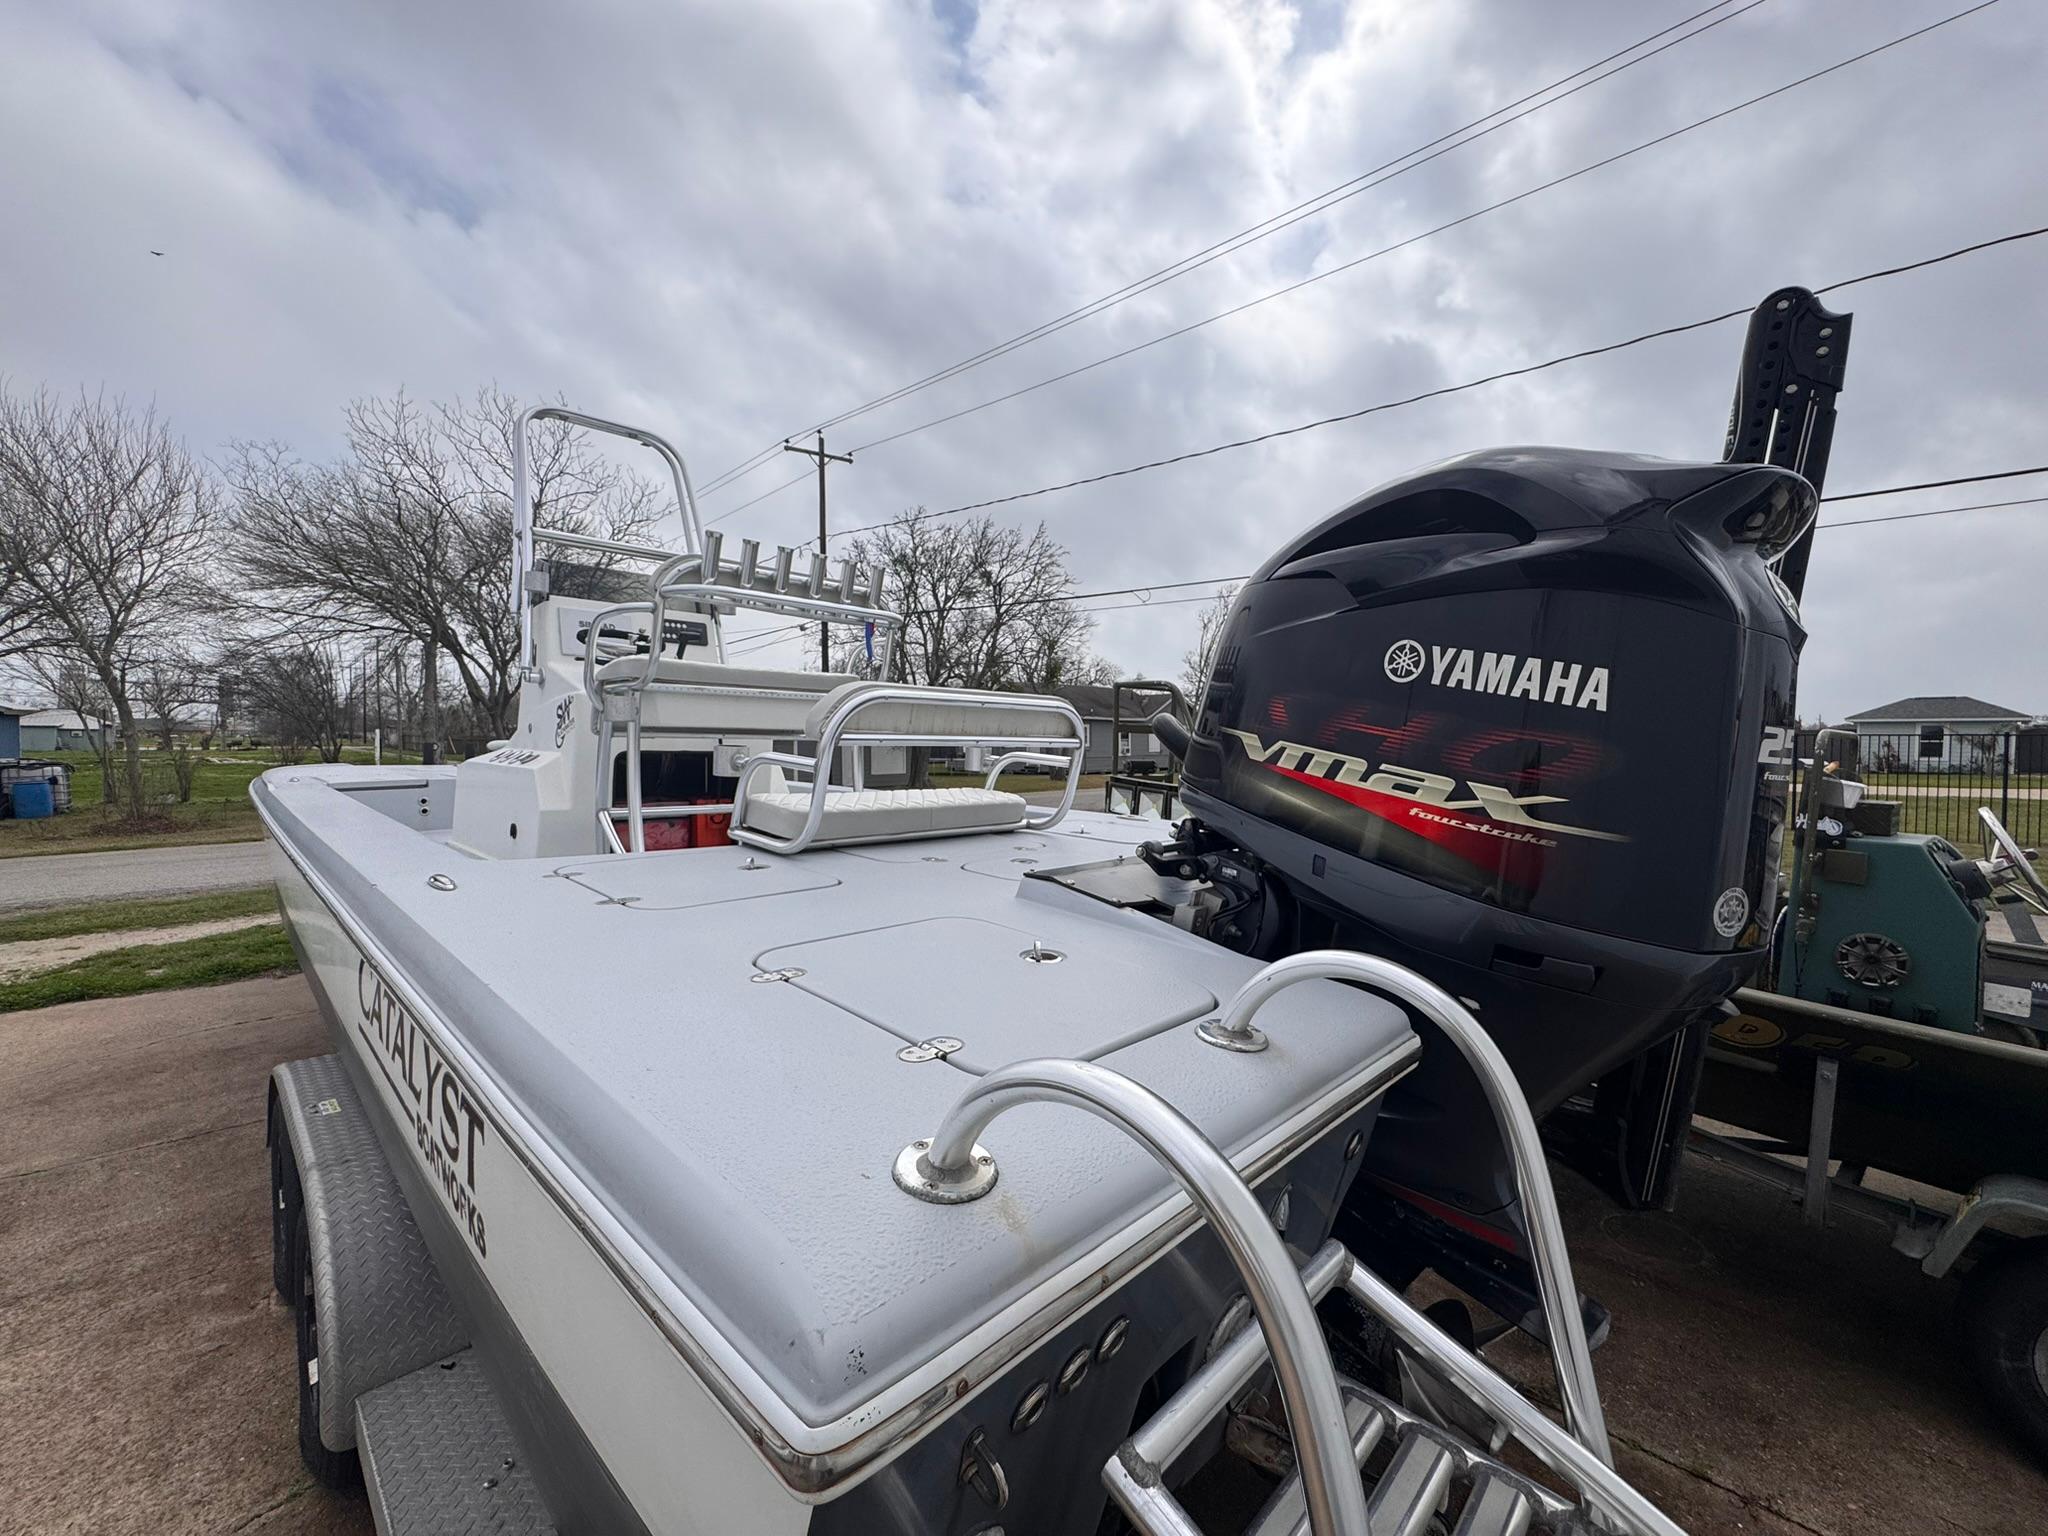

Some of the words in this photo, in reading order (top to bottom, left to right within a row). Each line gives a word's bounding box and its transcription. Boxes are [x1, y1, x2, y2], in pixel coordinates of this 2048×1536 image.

[1431, 645, 1609, 712] YAMAHA
[358, 957, 485, 1195] CATALYST
[416, 1111, 487, 1259] BOATWORKS
